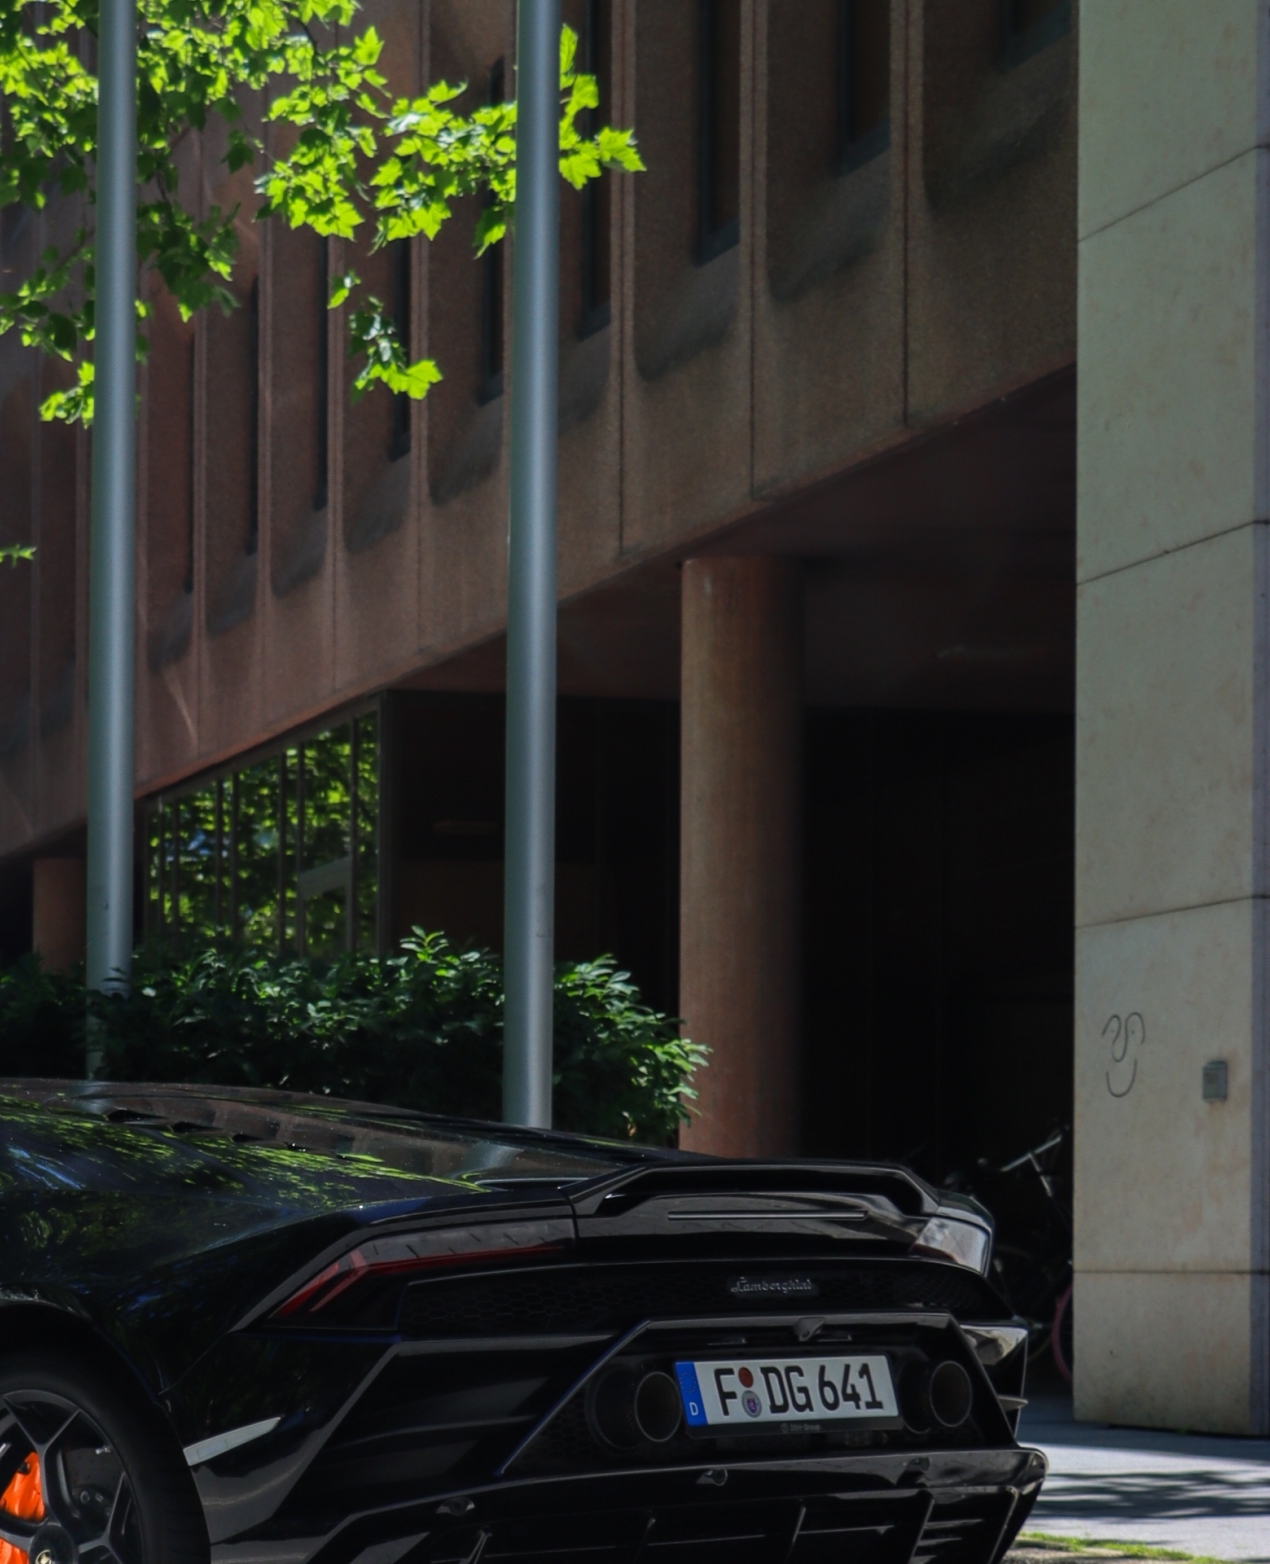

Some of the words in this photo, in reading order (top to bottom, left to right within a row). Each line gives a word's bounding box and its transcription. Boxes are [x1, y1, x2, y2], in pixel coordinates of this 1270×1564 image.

[731, 1277, 811, 1294] Lamborghini
[714, 1367, 738, 1416] F
[760, 1365, 814, 1414] DG
[818, 1363, 884, 1412] 641
[689, 1402, 699, 1416] D
